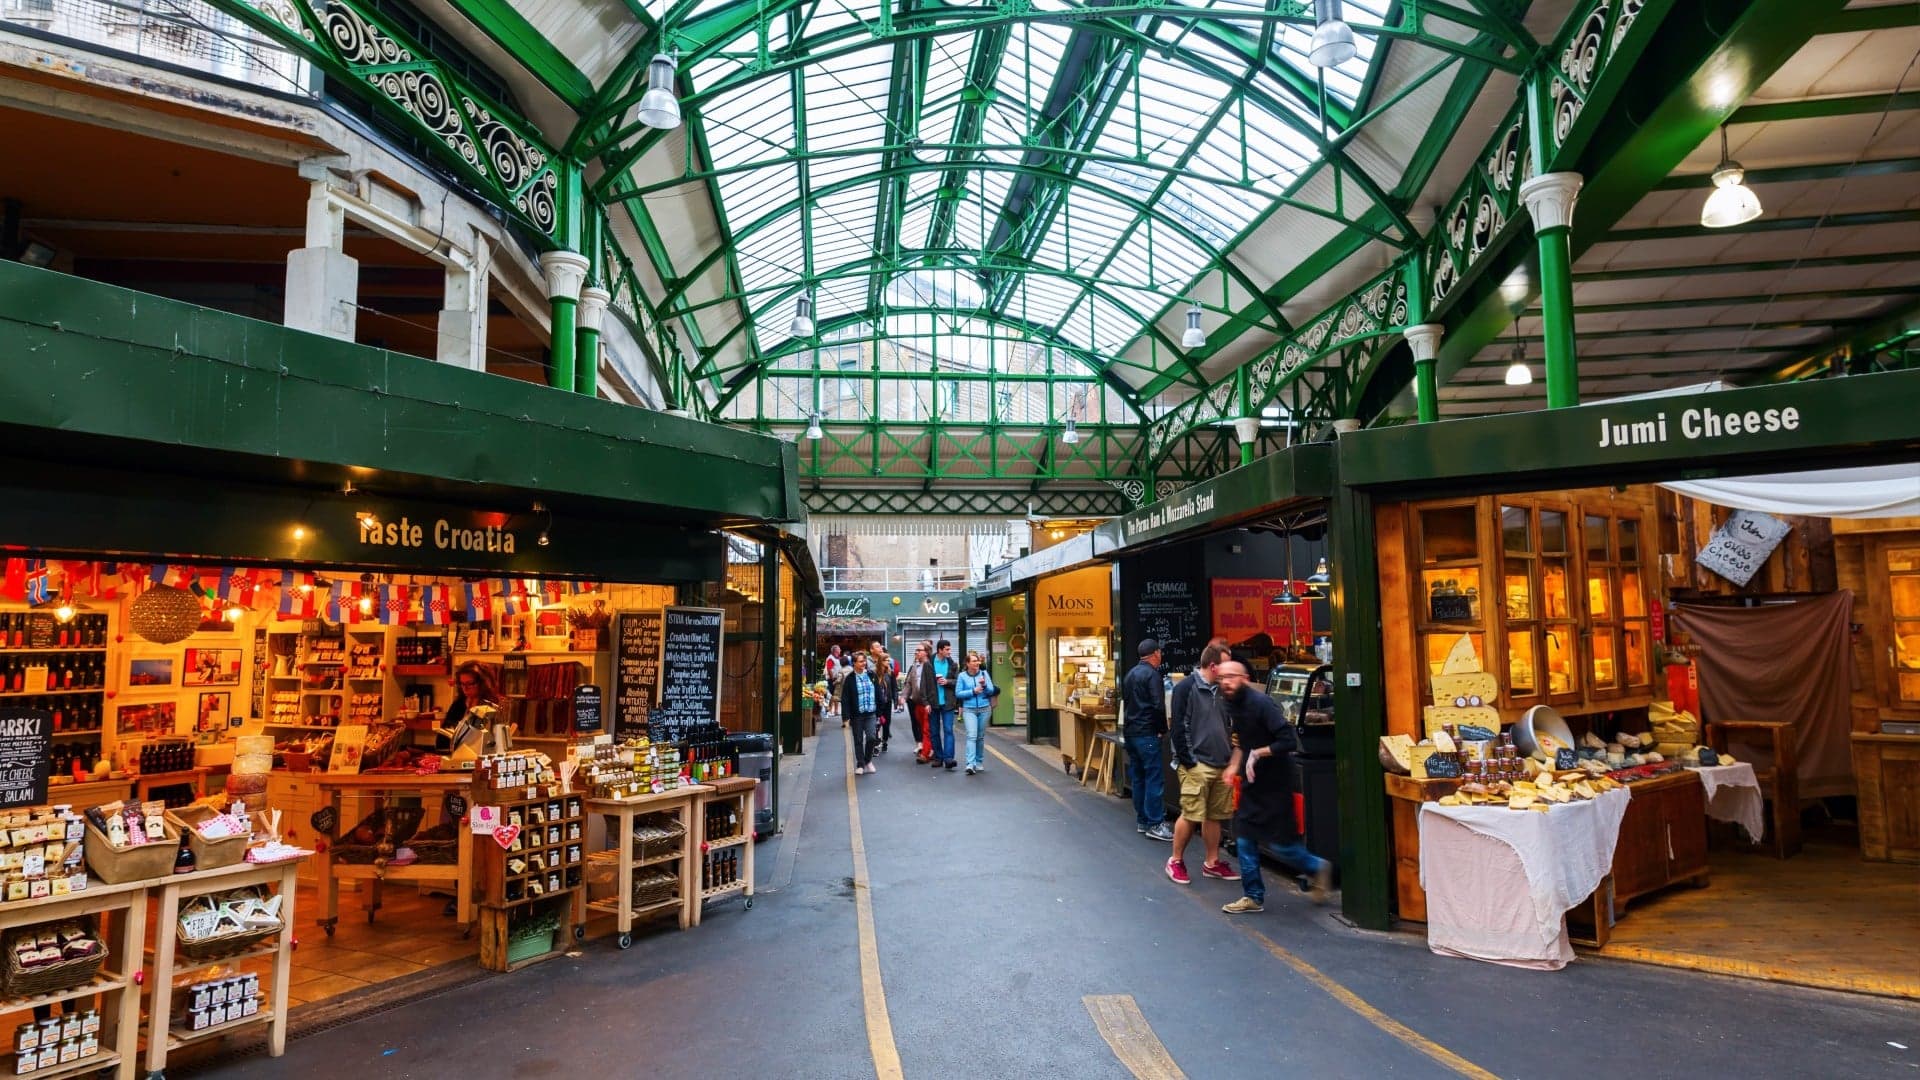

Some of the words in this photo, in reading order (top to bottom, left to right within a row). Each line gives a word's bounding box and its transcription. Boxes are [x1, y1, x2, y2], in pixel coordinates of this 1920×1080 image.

[1599, 412, 1667, 448] Jumi
[1681, 406, 1800, 440] Cheese
[356, 511, 423, 547] Taste
[434, 519, 515, 554] Croatia
[1127, 520, 1136, 537] The
[1135, 517, 1150, 533] Parma
[1150, 511, 1161, 529] Ham
[1166, 498, 1195, 524] Mozzarella
[1196, 489, 1214, 515] Stand
[5, 788, 34, 803] SALAMI
